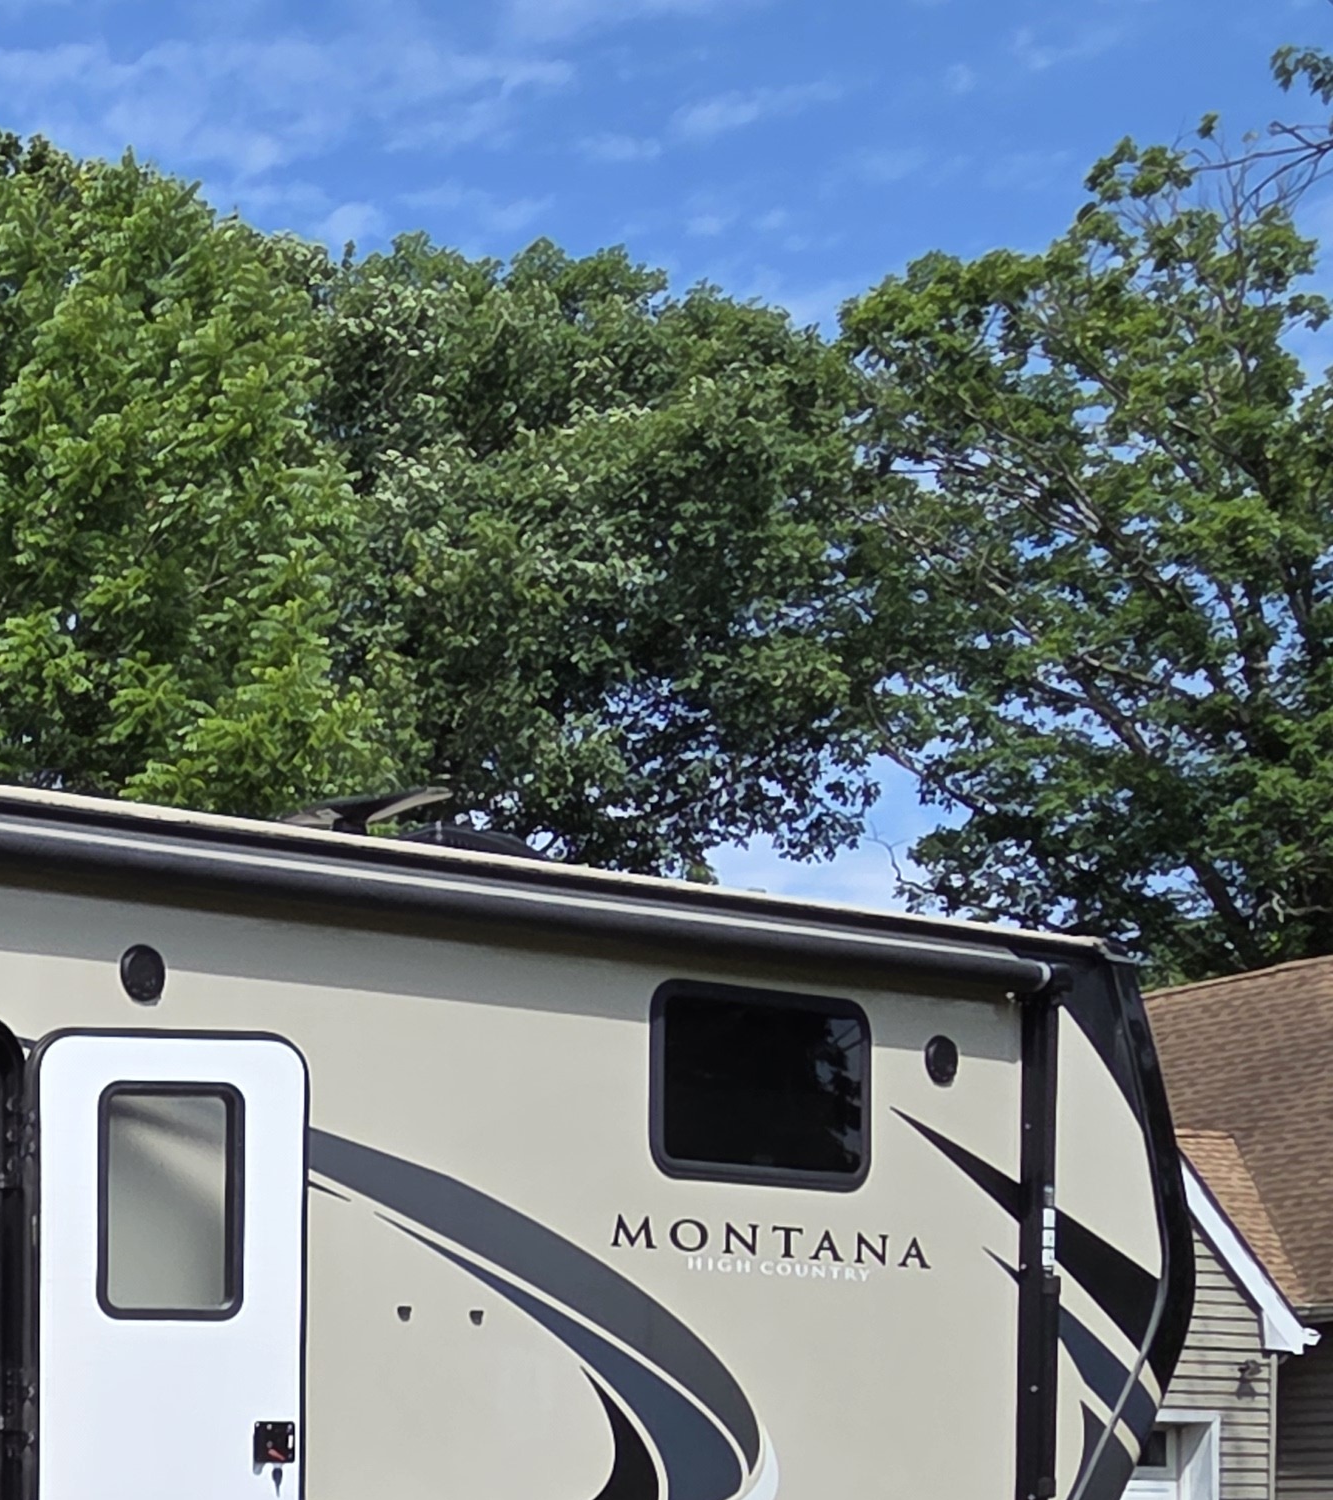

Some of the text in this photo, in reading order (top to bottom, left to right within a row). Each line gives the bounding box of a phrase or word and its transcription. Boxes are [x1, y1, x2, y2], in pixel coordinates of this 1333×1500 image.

[610, 1213, 932, 1269] MONTANA
[686, 1256, 871, 1283] HIGH COUNTRY
